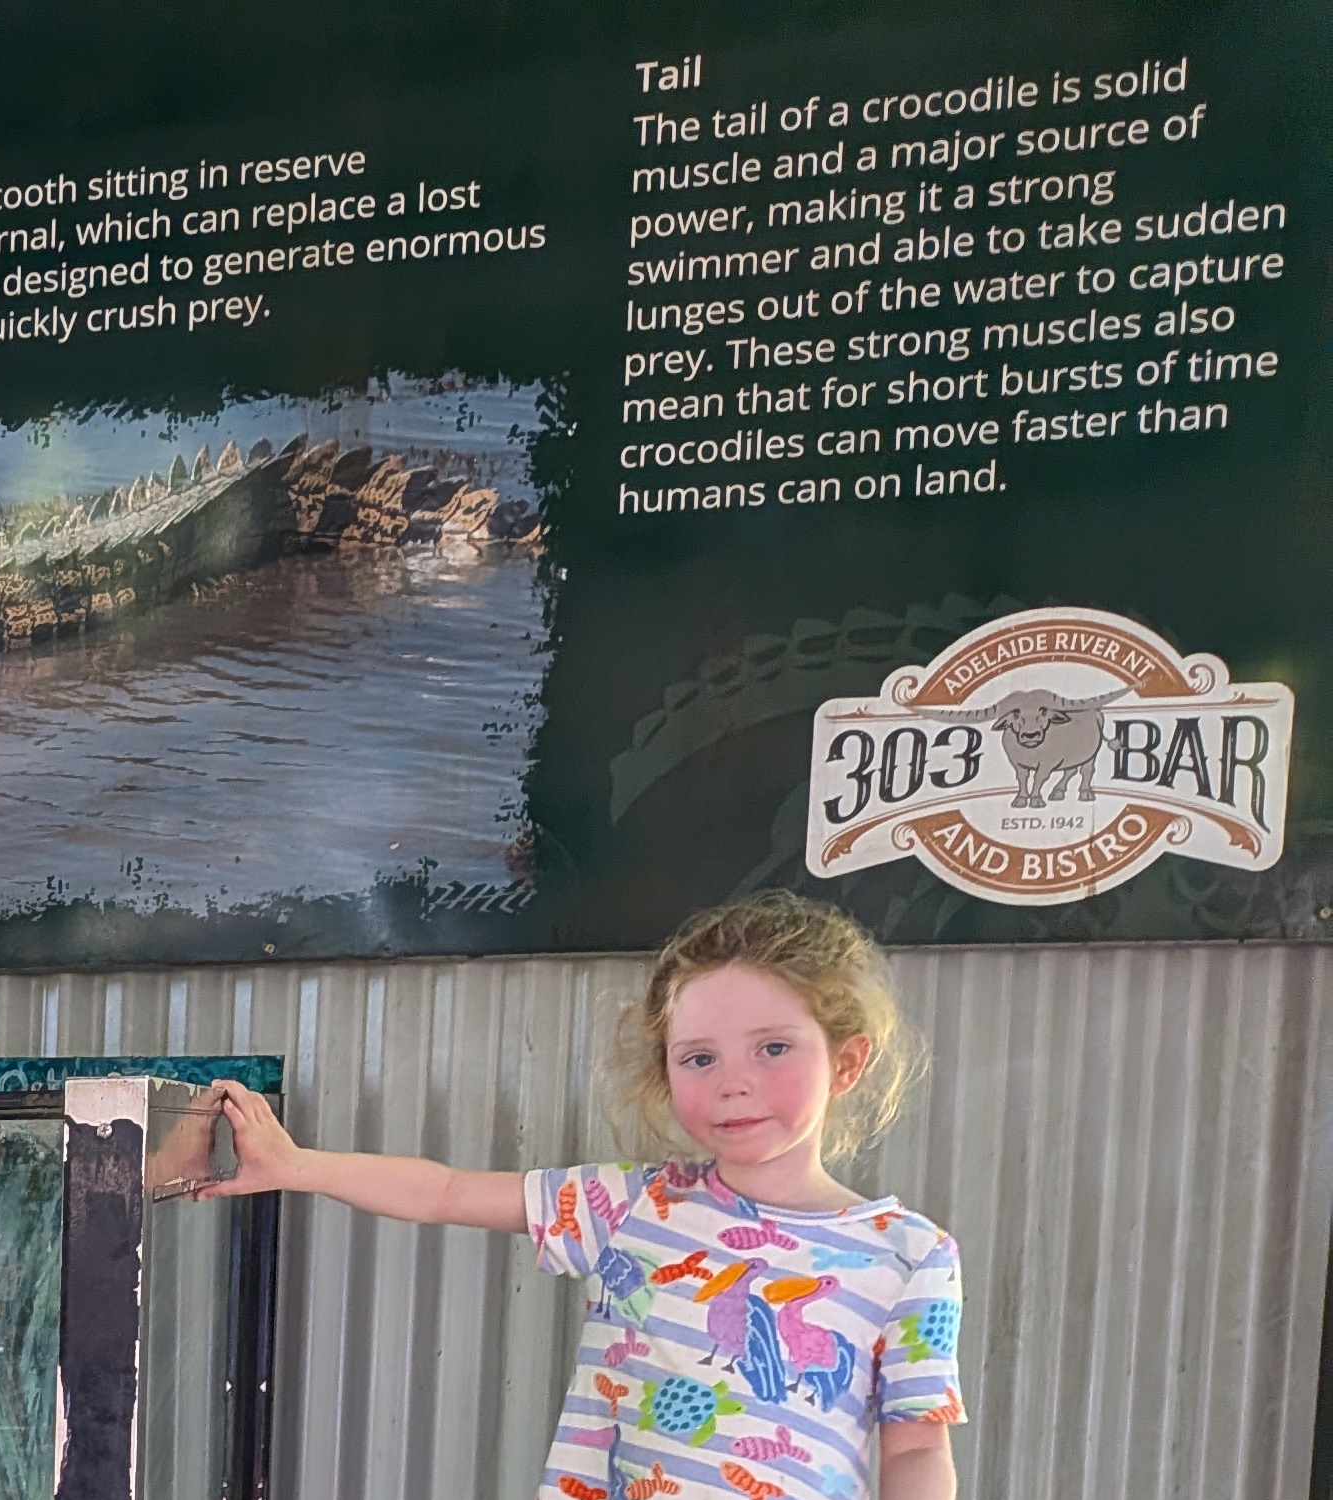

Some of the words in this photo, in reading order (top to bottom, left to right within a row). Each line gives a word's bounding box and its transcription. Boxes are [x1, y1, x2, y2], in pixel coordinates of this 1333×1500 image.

[632, 112, 701, 146] The
[711, 101, 767, 139] tail
[780, 95, 821, 132] of
[828, 101, 849, 127] a
[862, 75, 1039, 123] crocodile
[1052, 71, 1081, 105] is
[1093, 56, 1187, 100] solid
[635, 54, 702, 93] Tail
[87, 165, 189, 201] sitting
[199, 159, 228, 190] in
[240, 151, 366, 186] reserve
[632, 151, 762, 194] muscle
[773, 141, 844, 179] and
[856, 146, 877, 172] a
[891, 129, 1005, 172] major
[1016, 119, 1150, 156] source
[1163, 103, 1207, 141] of
[75, 208, 171, 246] which
[182, 208, 240, 235] can
[252, 192, 376, 234] replace
[386, 192, 405, 216] a
[418, 180, 481, 213] lost
[627, 247, 800, 286] swimmer
[810, 232, 881, 270] and
[893, 225, 975, 263] able
[986, 225, 1025, 254] to
[1038, 213, 1122, 250] take
[1135, 198, 1286, 242] sudden
[630, 205, 754, 249] power,
[768, 187, 907, 227] making
[918, 181, 943, 214] it
[953, 184, 974, 210] a
[987, 170, 1116, 207] strong
[944, 632, 1048, 696] ADELAIDE
[1054, 631, 1121, 662] RIVER
[1121, 650, 1156, 679] NT
[823, 724, 983, 825] 303
[1111, 714, 1272, 834] BAR
[932, 822, 1010, 875] AND
[1020, 812, 1148, 881] BISTRO
[1000, 816, 1047, 830] ESTD.
[1050, 815, 1084, 829] 1942
